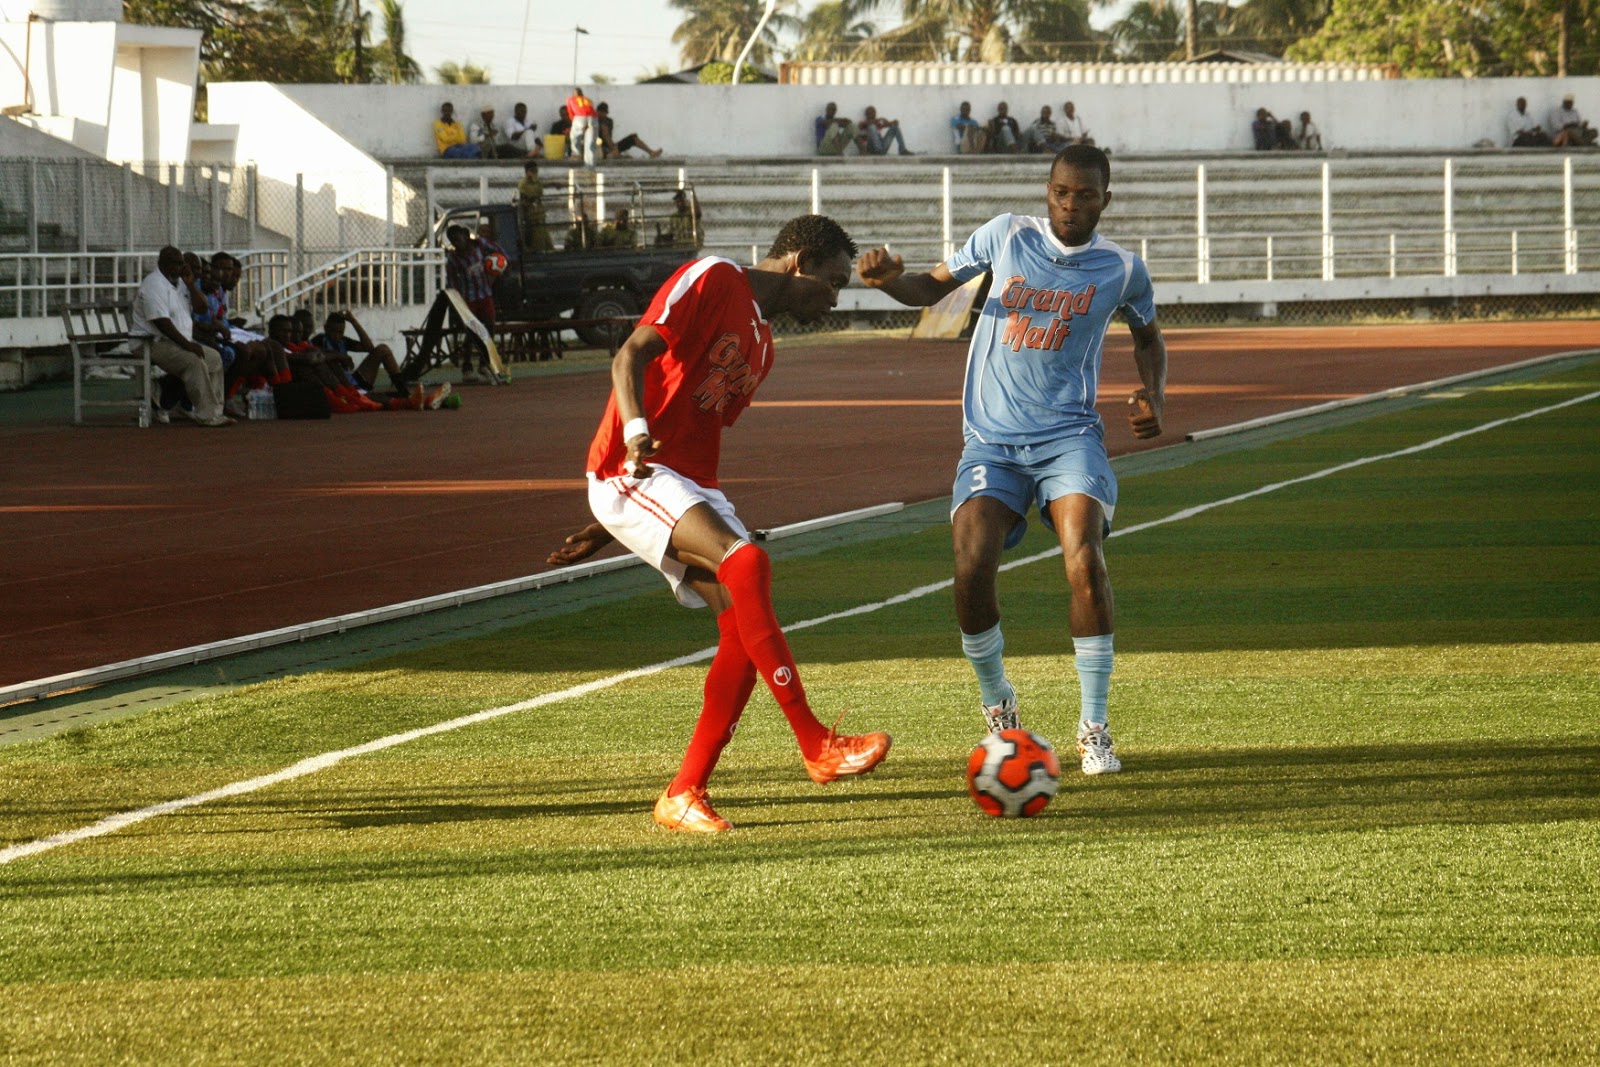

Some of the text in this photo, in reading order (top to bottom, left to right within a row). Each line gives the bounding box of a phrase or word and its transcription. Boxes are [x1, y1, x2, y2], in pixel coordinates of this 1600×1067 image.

[1000, 275, 1097, 321] Grand
[1001, 309, 1071, 352] Malt
[969, 464, 988, 492] 3
